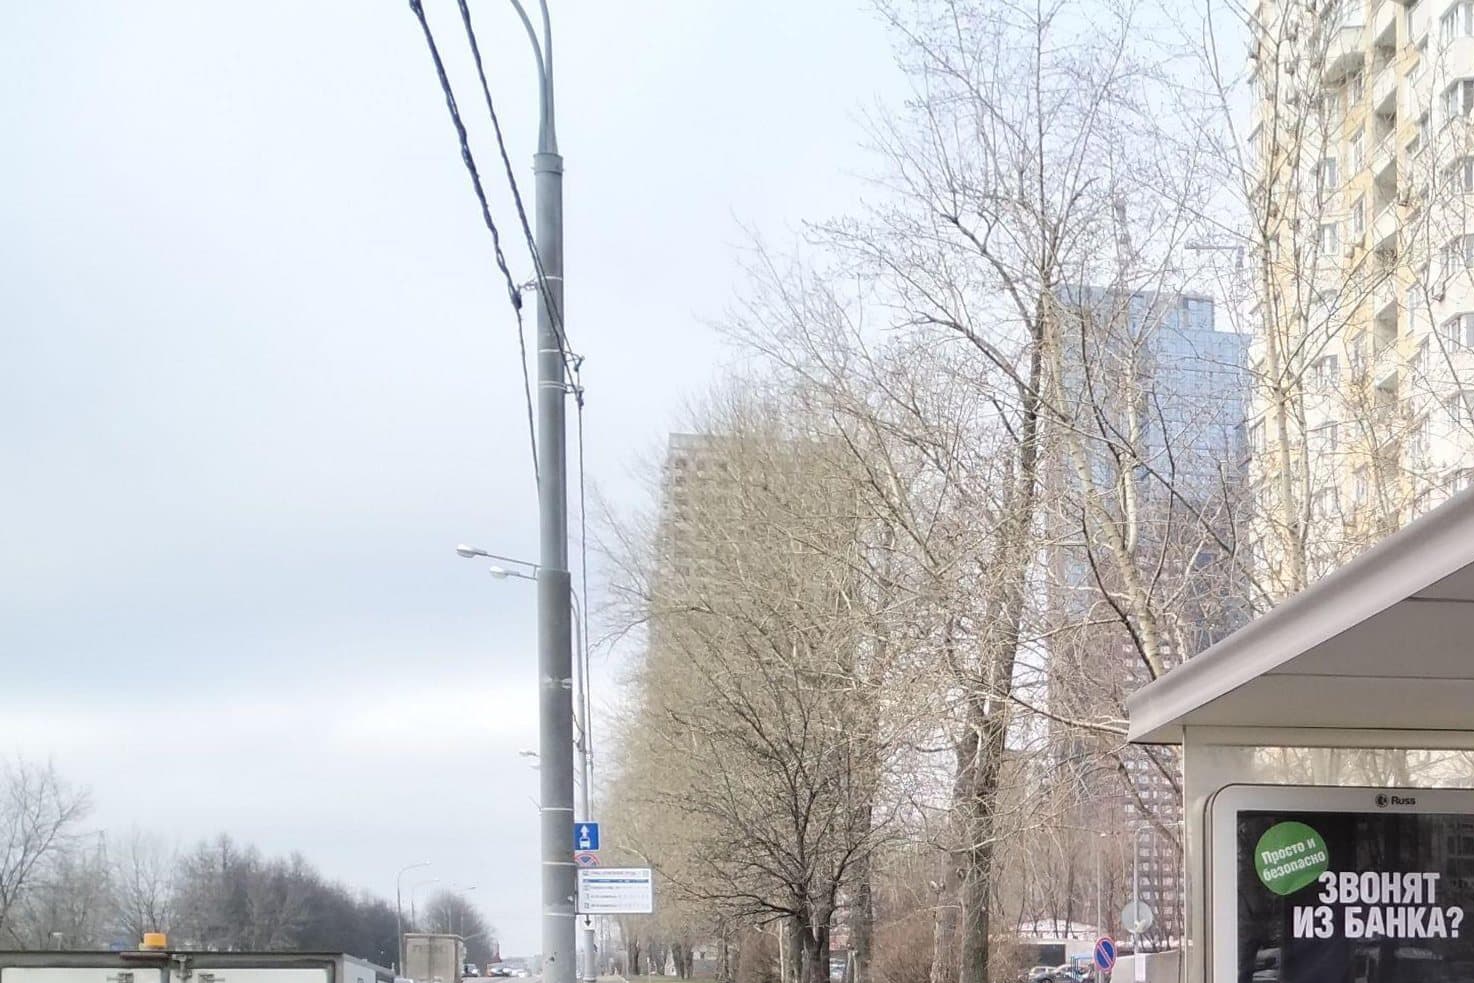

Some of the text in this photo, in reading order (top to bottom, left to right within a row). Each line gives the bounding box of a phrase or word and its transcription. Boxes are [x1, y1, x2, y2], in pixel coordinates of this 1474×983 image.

[1261, 837, 1317, 866] Просто и
[1262, 851, 1327, 883] безопасно
[1318, 870, 1441, 905] ЗВОНЯТ
[1292, 905, 1465, 939] ИЗ БАНКА?
